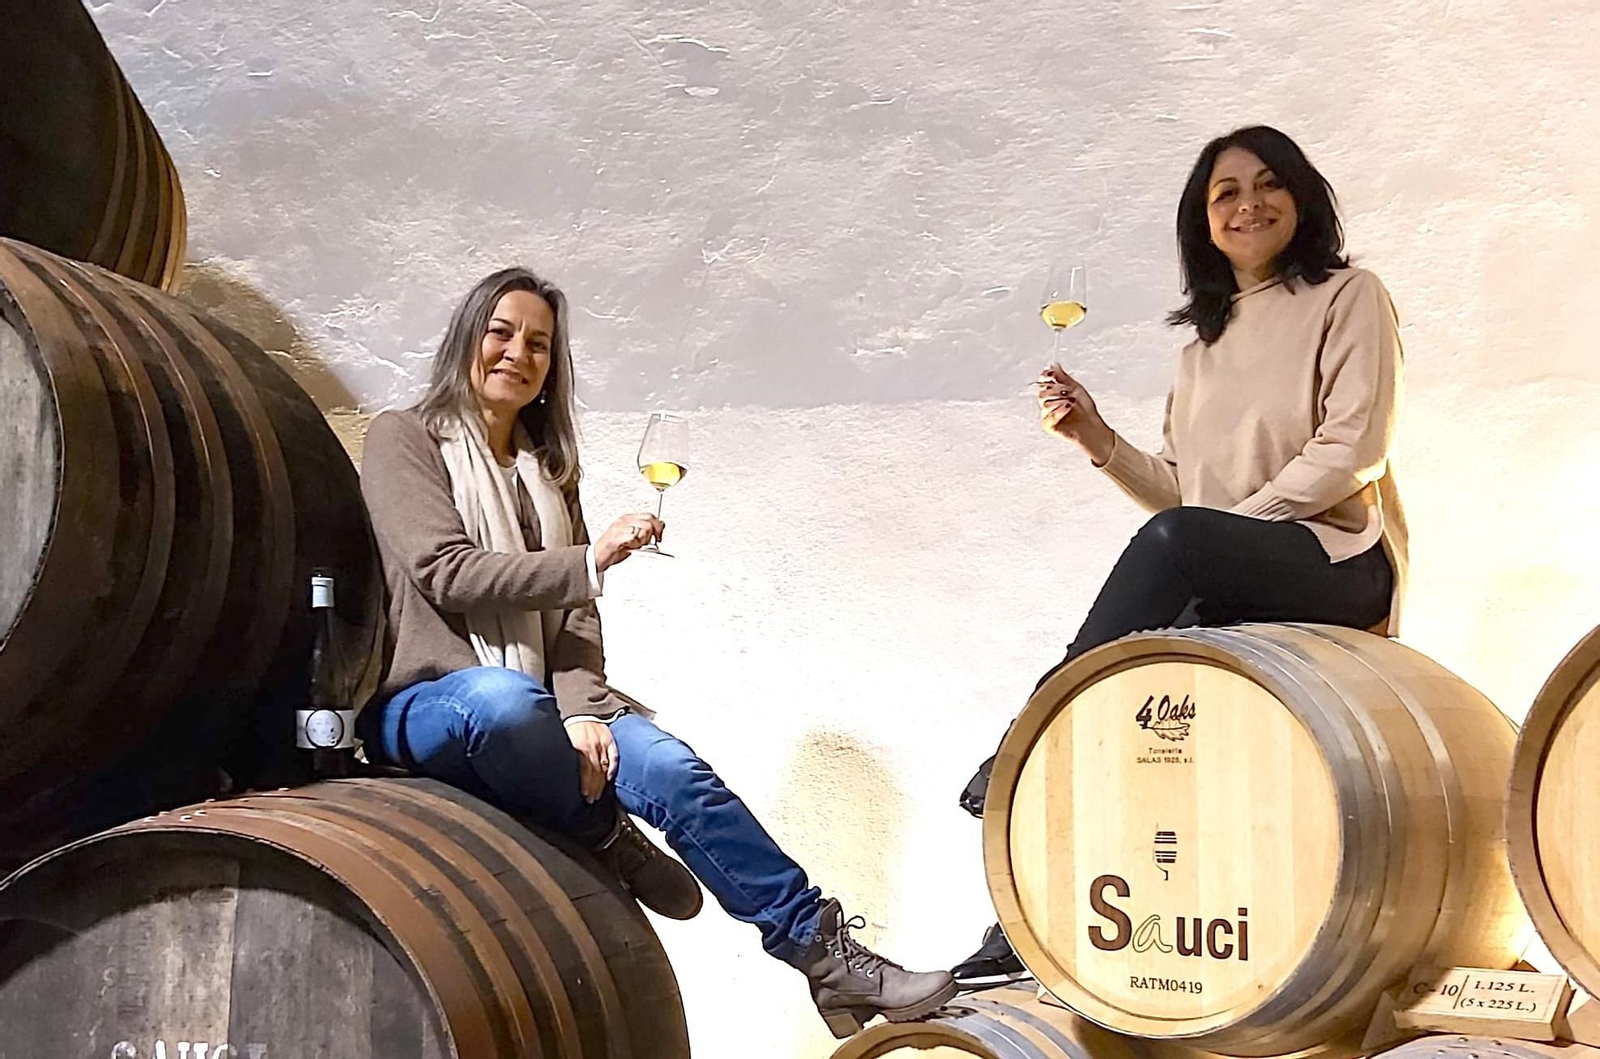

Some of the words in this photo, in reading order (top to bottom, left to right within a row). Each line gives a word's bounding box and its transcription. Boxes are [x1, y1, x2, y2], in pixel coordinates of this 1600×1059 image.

[1135, 695, 1154, 729] 4
[1157, 694, 1196, 721] Oaks
[1088, 874, 1248, 961] Sauci
[1130, 976, 1203, 994] RATM0419
[1474, 980, 1515, 991] 1.125
[1518, 983, 1536, 993] L.
[1488, 1000, 1513, 1009] 225
[1515, 1002, 1537, 1013] L.)
